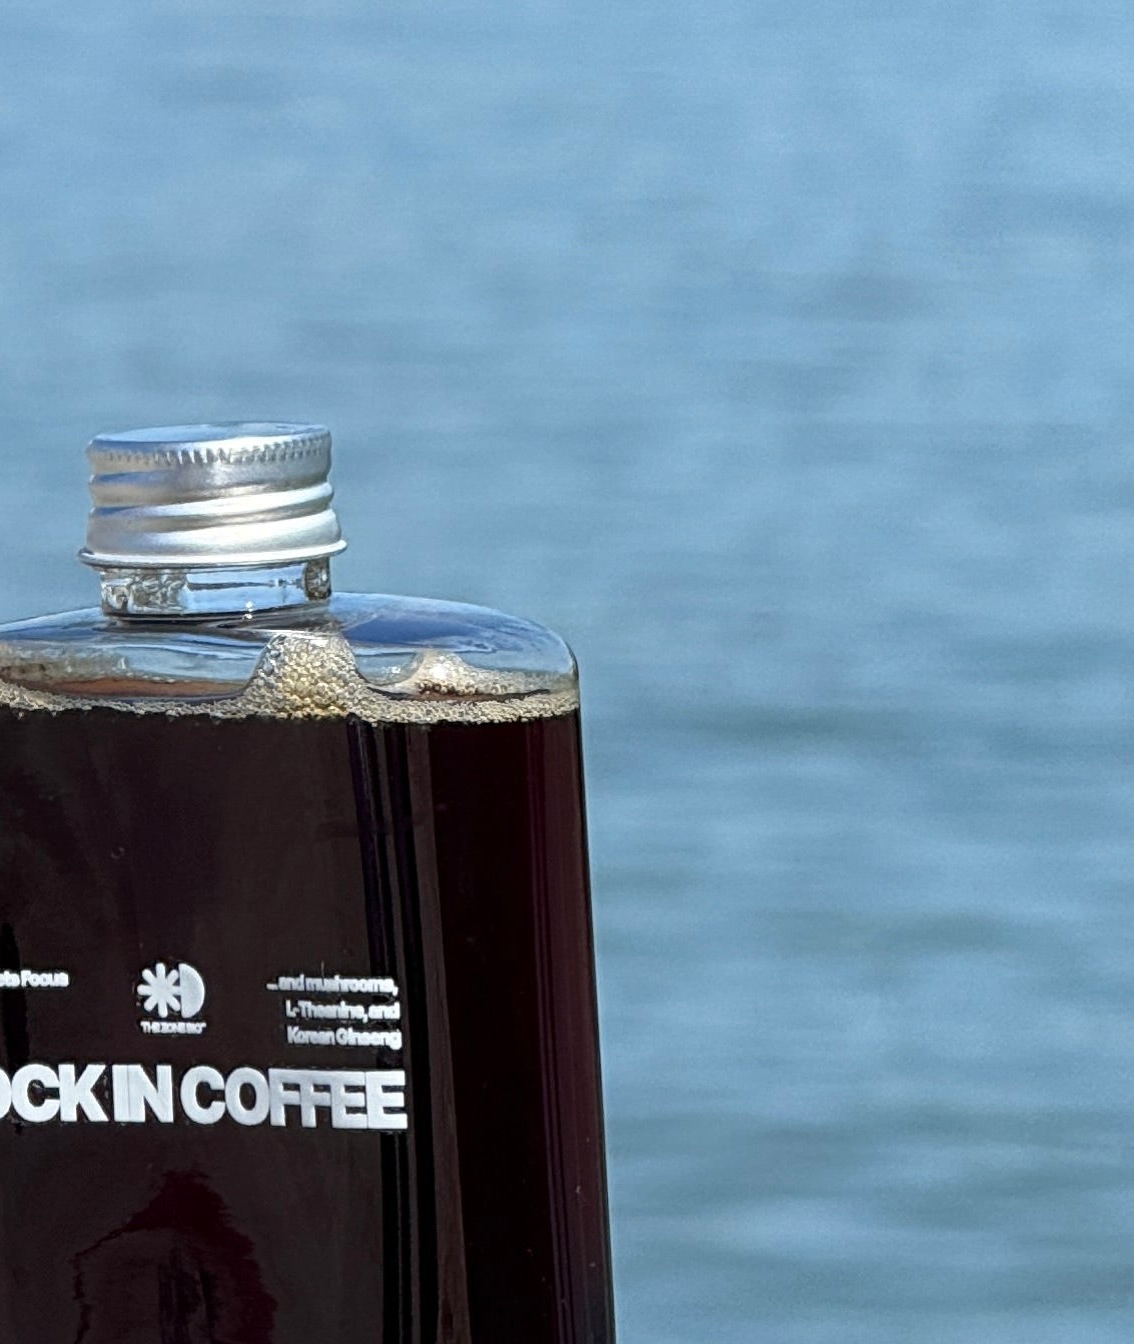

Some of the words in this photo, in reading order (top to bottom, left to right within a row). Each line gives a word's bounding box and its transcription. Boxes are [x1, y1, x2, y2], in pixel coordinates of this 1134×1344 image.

[20, 969, 70, 987] Focus
[368, 1001, 401, 1019] and
[287, 1026, 335, 1045] Korean
[336, 1027, 403, 1050] Ginseng
[180, 1066, 408, 1129] COFFEE
